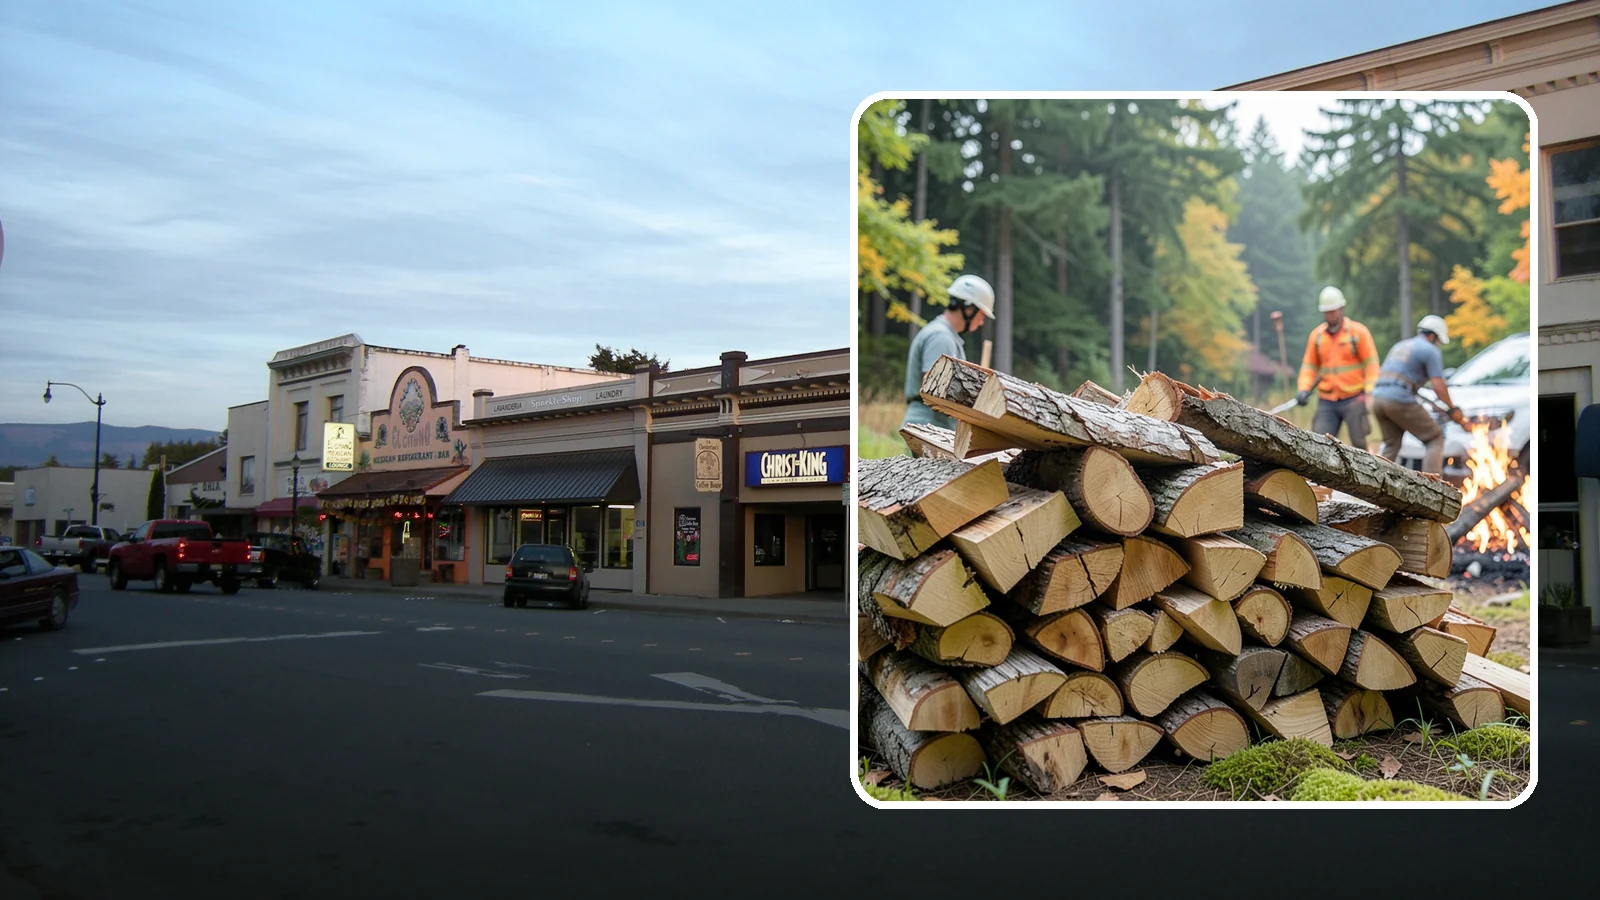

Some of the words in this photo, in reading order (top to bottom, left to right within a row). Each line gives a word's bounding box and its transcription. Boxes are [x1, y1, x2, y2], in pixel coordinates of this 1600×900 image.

[493, 402, 522, 412] LAVANDERIA
[531, 398, 560, 409] Sparkle
[561, 394, 583, 405] Shop
[595, 389, 623, 400] LAUNDRY
[373, 455, 396, 464] MEXICAN
[397, 451, 434, 462] RESTAURANT
[437, 450, 450, 459] BAR
[760, 452, 798, 478] CHRIST
[799, 449, 828, 476] KING
